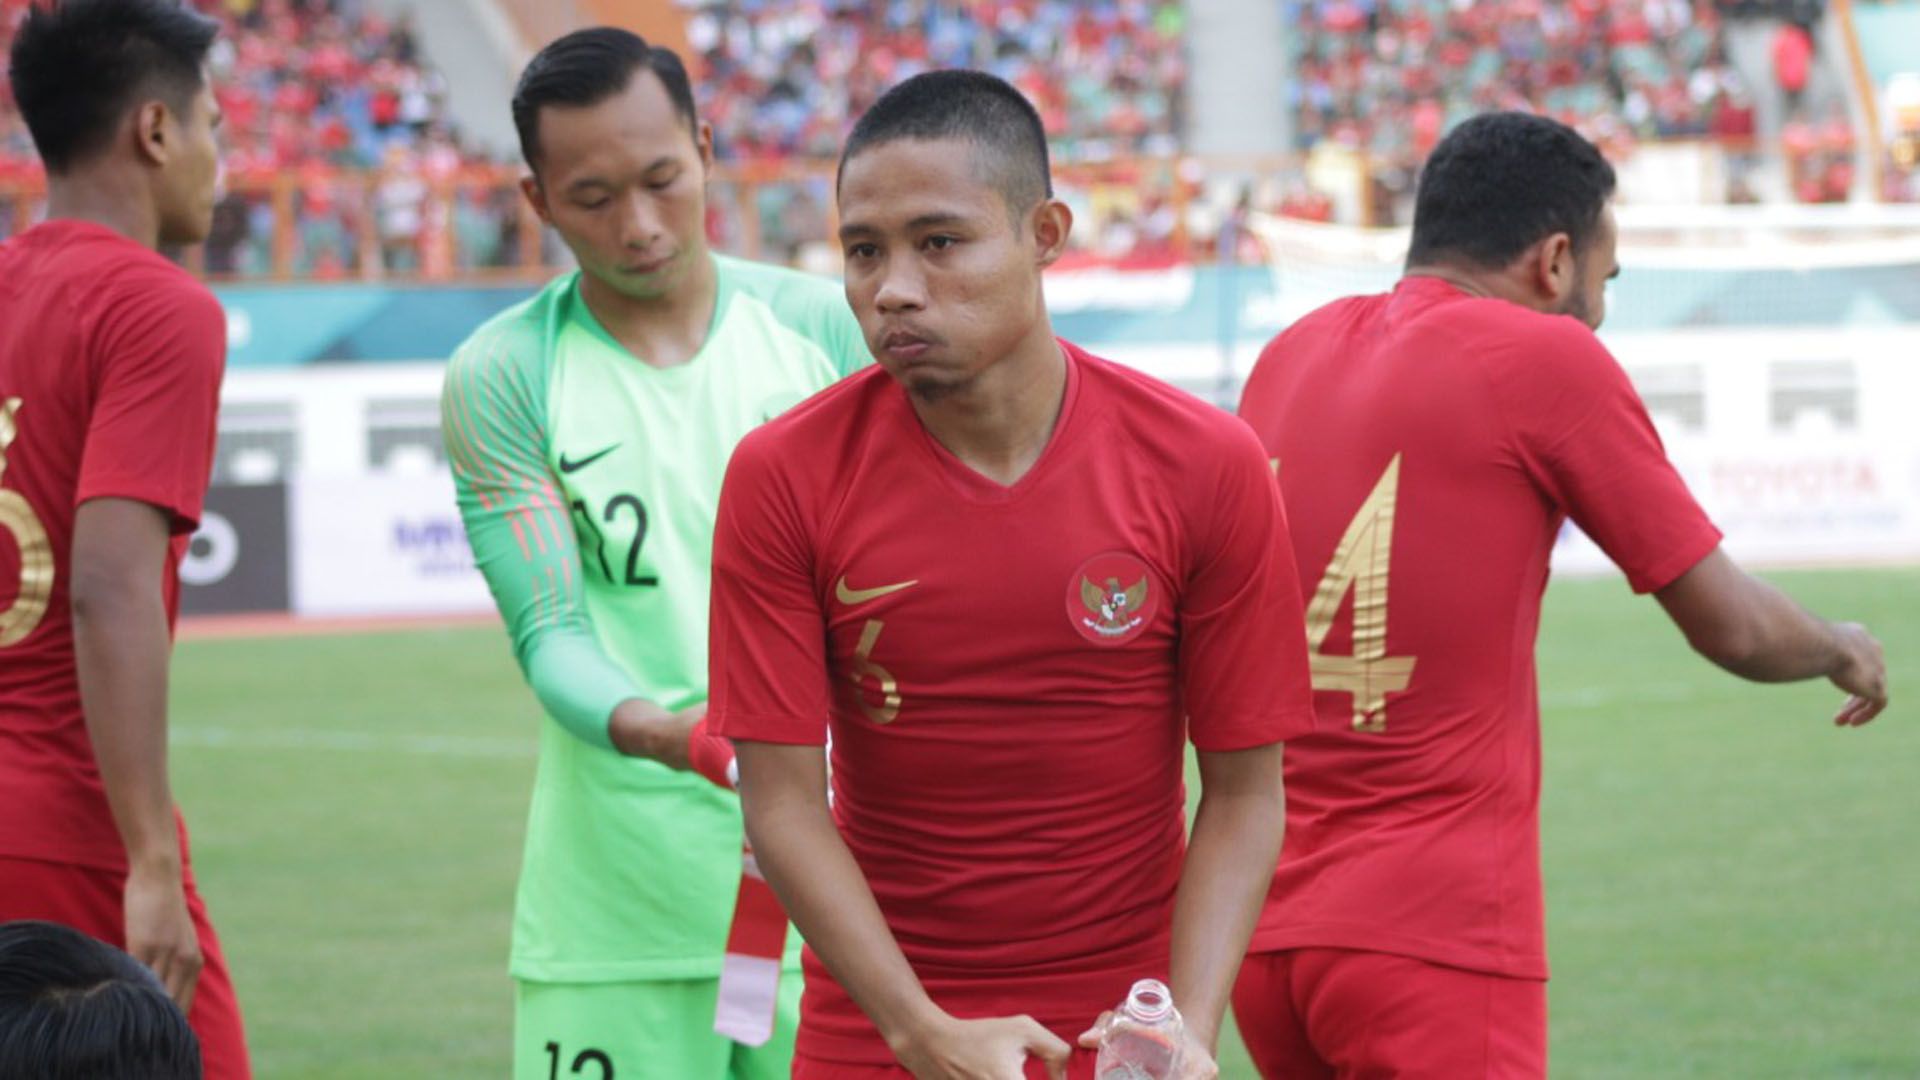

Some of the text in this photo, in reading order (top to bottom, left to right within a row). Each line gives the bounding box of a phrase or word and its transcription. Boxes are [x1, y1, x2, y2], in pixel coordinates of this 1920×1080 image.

[572, 493, 659, 586] 12
[1269, 450, 1417, 732] 4
[851, 619, 902, 724] 6
